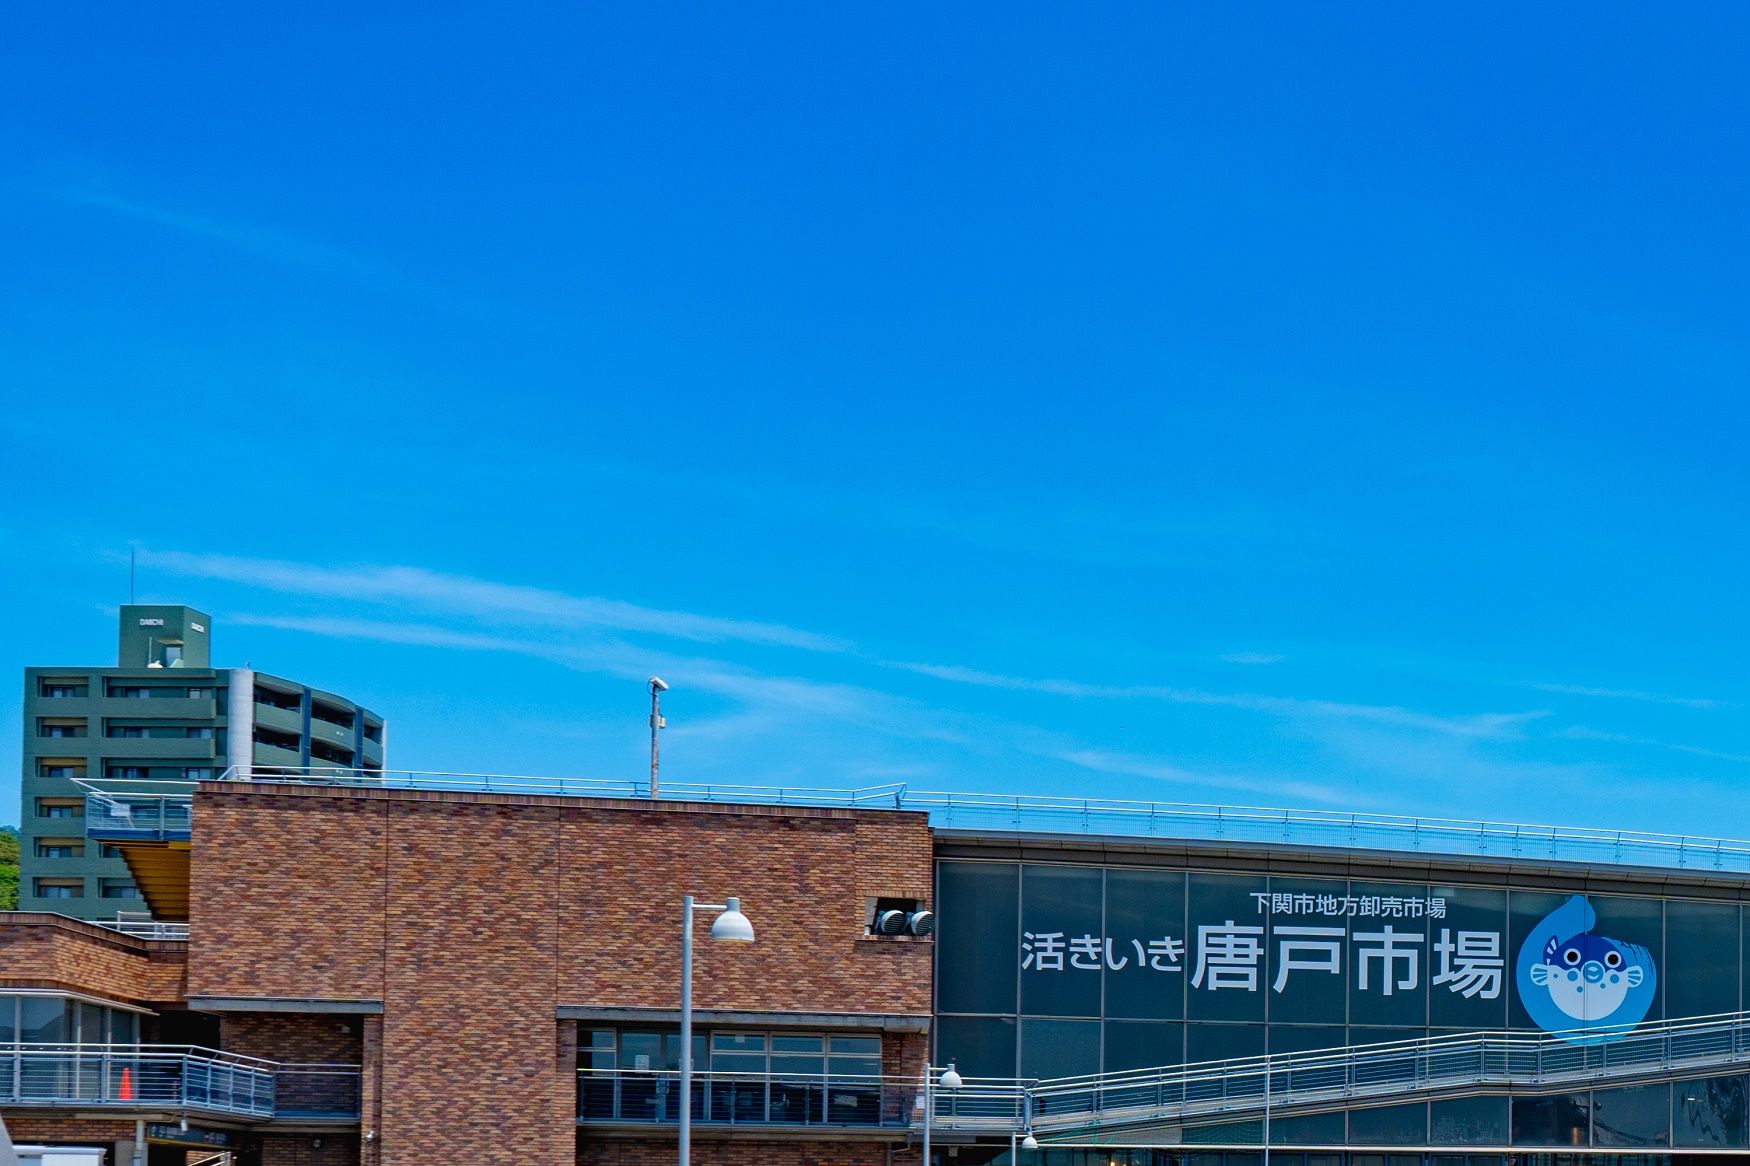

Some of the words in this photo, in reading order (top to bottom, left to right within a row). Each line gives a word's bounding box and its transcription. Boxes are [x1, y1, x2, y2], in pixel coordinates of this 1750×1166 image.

[1249, 892, 1447, 919] 下関市地方卸売市場
[1021, 931, 1185, 972] 活きいき
[1190, 920, 1504, 999] 唐戸市場
